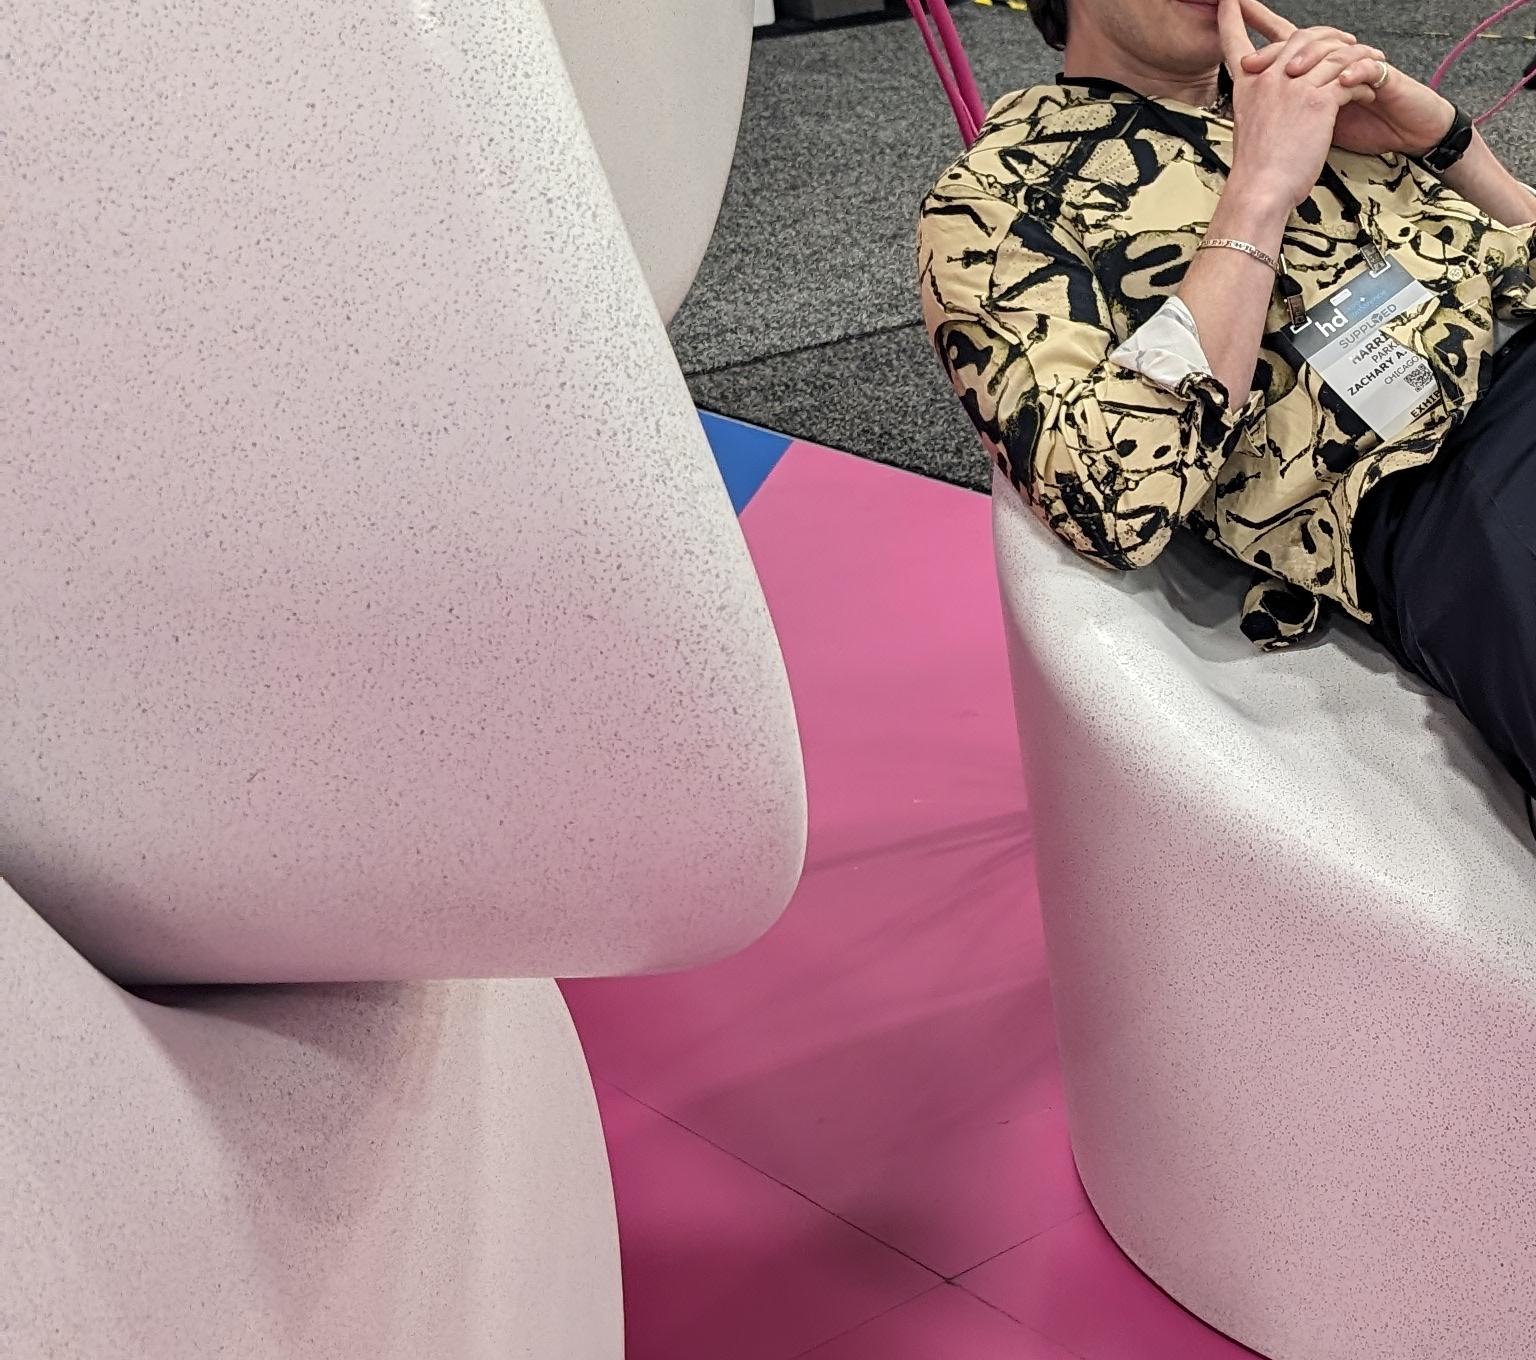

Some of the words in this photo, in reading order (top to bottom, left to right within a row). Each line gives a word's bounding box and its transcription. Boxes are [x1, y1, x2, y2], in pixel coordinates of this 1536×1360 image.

[1314, 307, 1349, 338] hd
[1351, 331, 1391, 365] HARRI
[1347, 355, 1395, 397] ZACHARY
[1410, 390, 1442, 418] EXHIB
